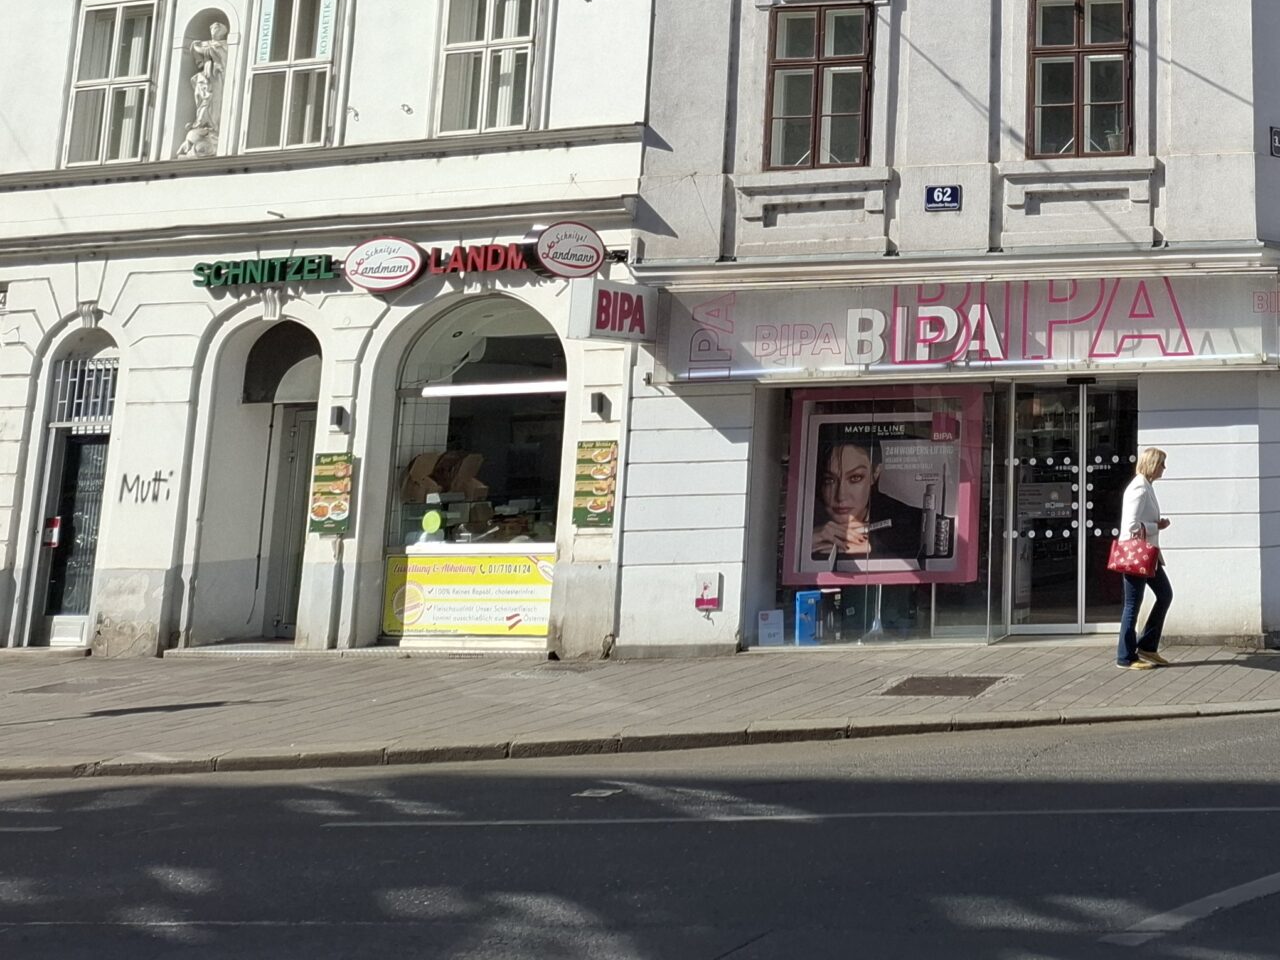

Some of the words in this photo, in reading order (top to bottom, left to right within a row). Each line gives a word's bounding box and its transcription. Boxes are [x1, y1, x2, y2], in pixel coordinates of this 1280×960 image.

[320, 1, 332, 55] KOSMETIK
[933, 187, 952, 202] 62
[555, 231, 588, 244] Schnitzel
[364, 245, 401, 260] Schnitzel
[542, 241, 595, 263] Landmann
[193, 255, 336, 287] SCHNITZEL
[349, 257, 409, 276] Landmann
[596, 289, 646, 334] BIPA
[891, 277, 1194, 365] BIPA
[754, 322, 841, 357] BIPA
[844, 303, 1004, 366] BIPA
[844, 425, 905, 433] MAYBELLINE
[933, 432, 953, 440] BIPA
[119, 470, 174, 503] Mutti
